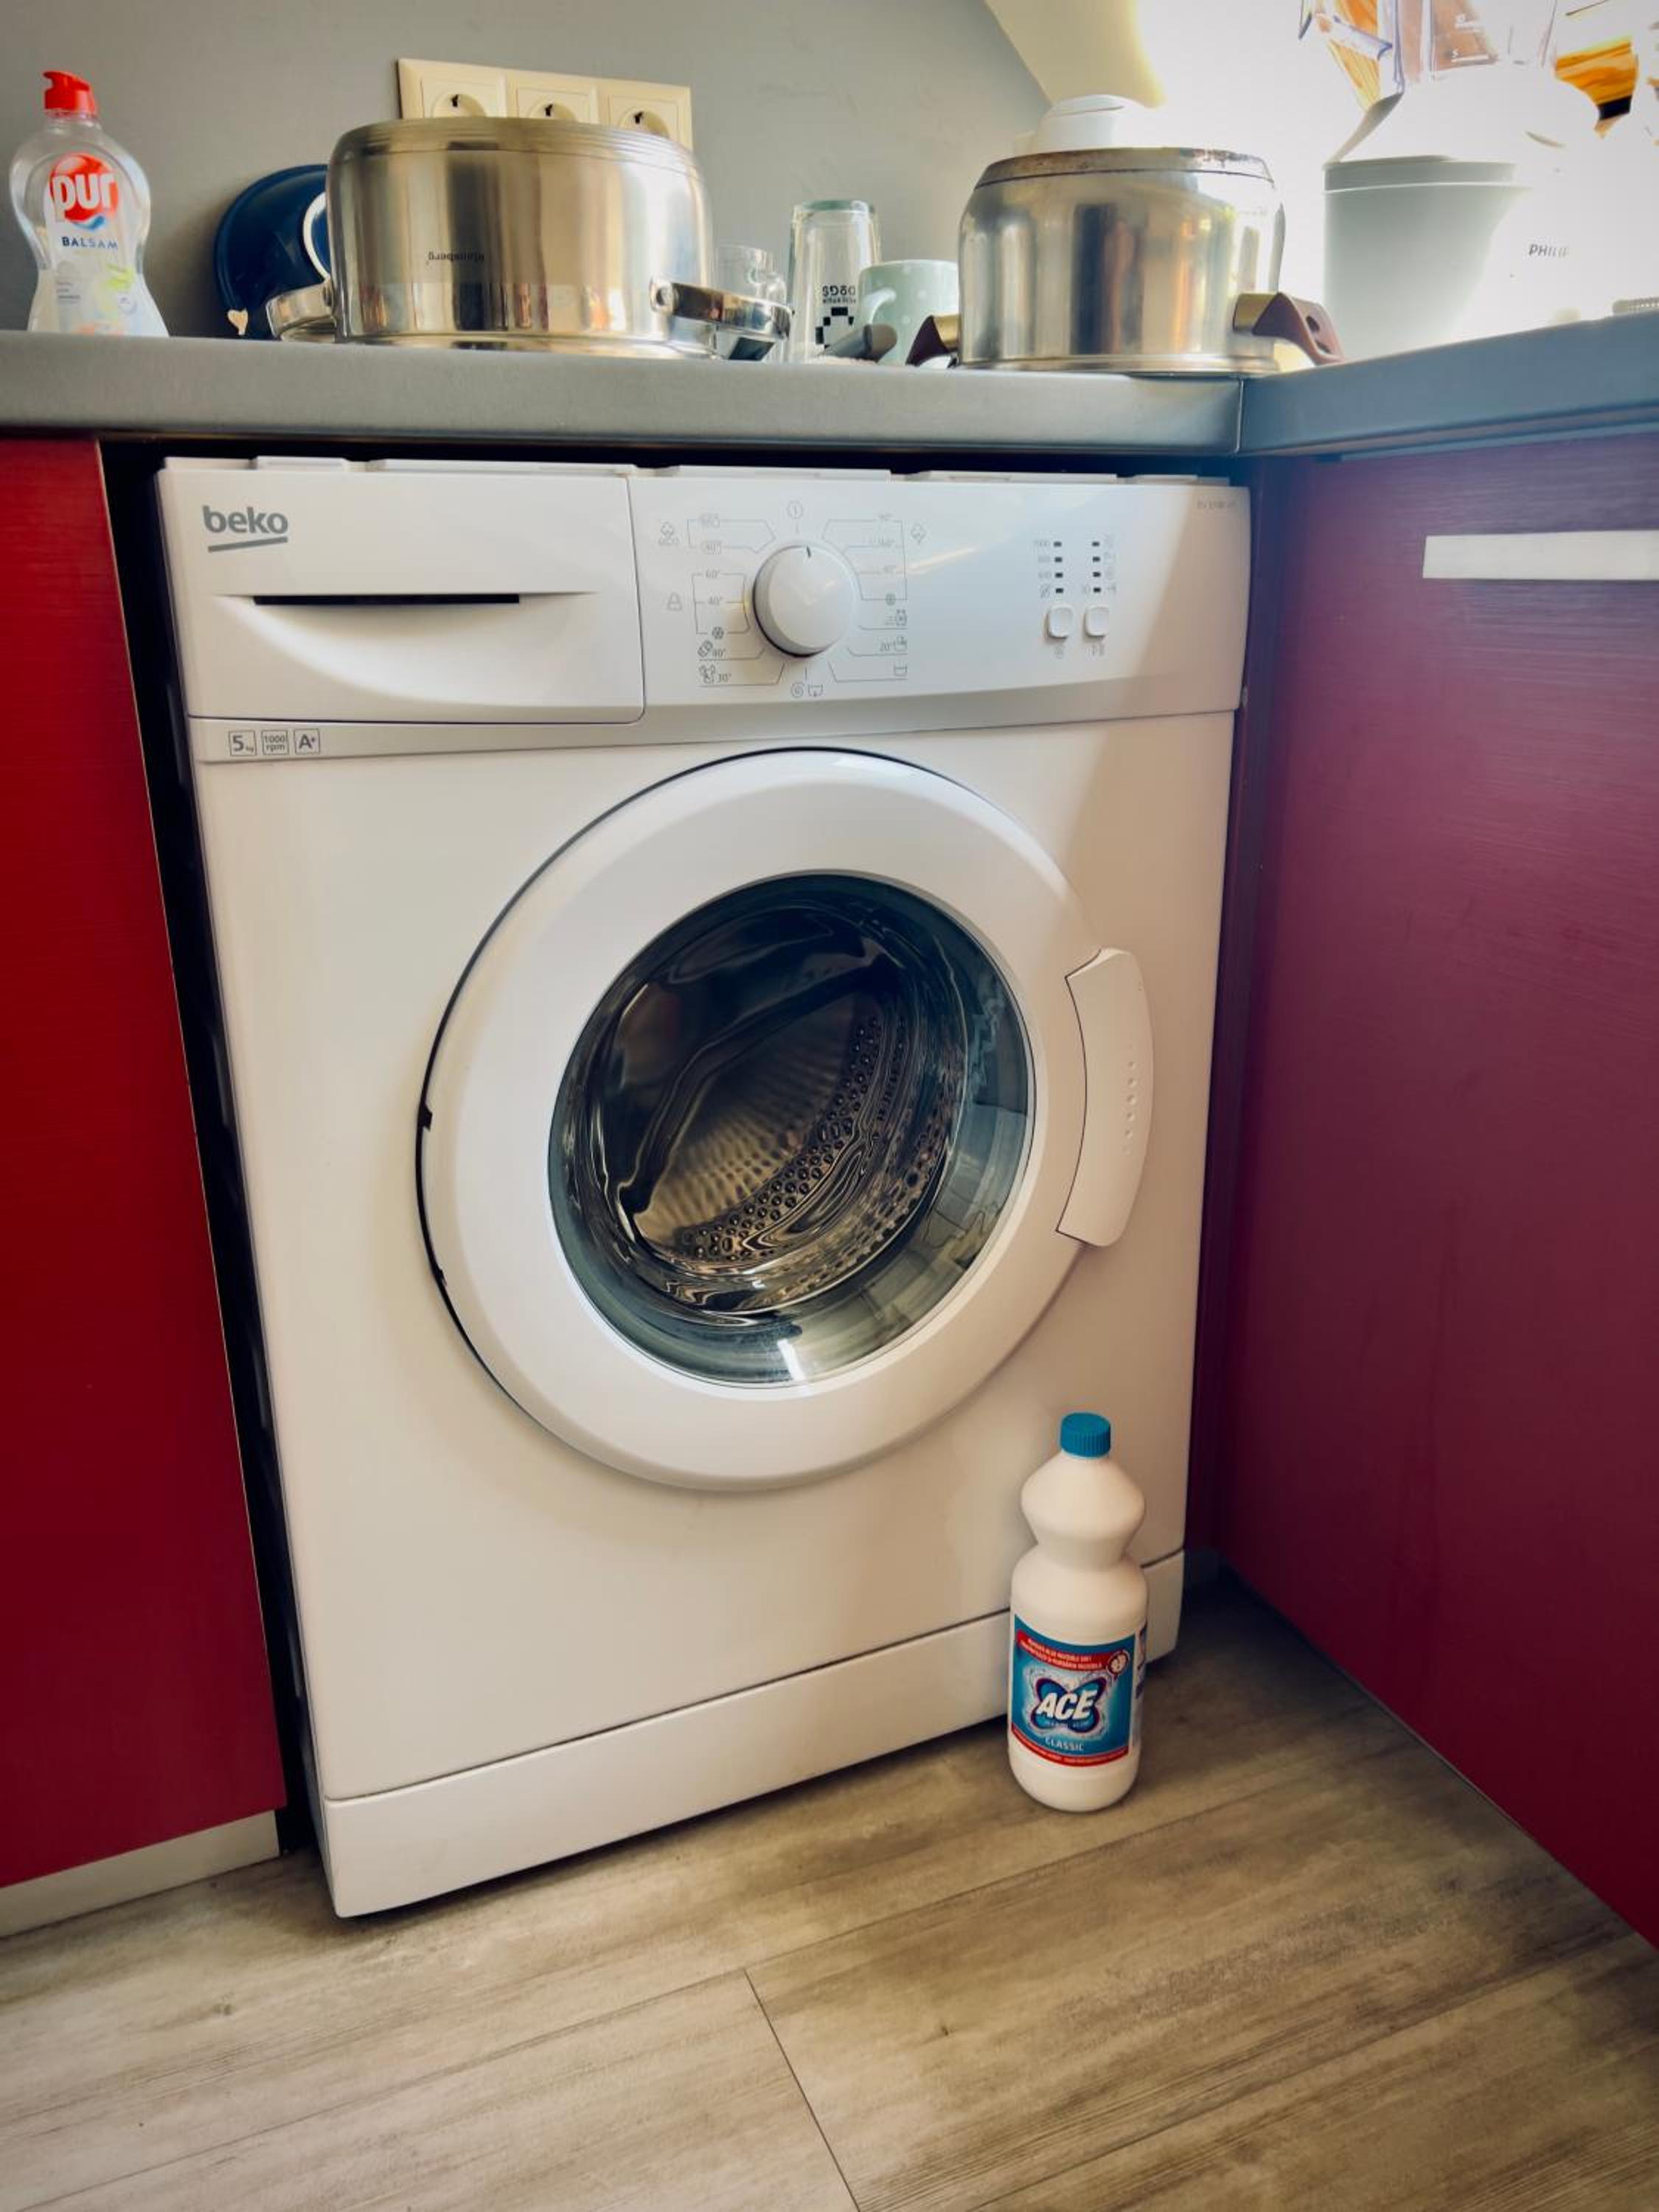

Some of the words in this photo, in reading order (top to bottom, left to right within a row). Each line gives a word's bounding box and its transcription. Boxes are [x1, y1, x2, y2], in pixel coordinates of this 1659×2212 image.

[52, 170, 117, 223] pur
[61, 235, 119, 249] BALSAM
[202, 504, 288, 534] beko
[232, 734, 245, 751] 5
[263, 735, 285, 743] 1000
[265, 744, 285, 753] rpm
[1036, 1689, 1098, 1720] ACE
[1044, 1736, 1085, 1752] CLASSIC
